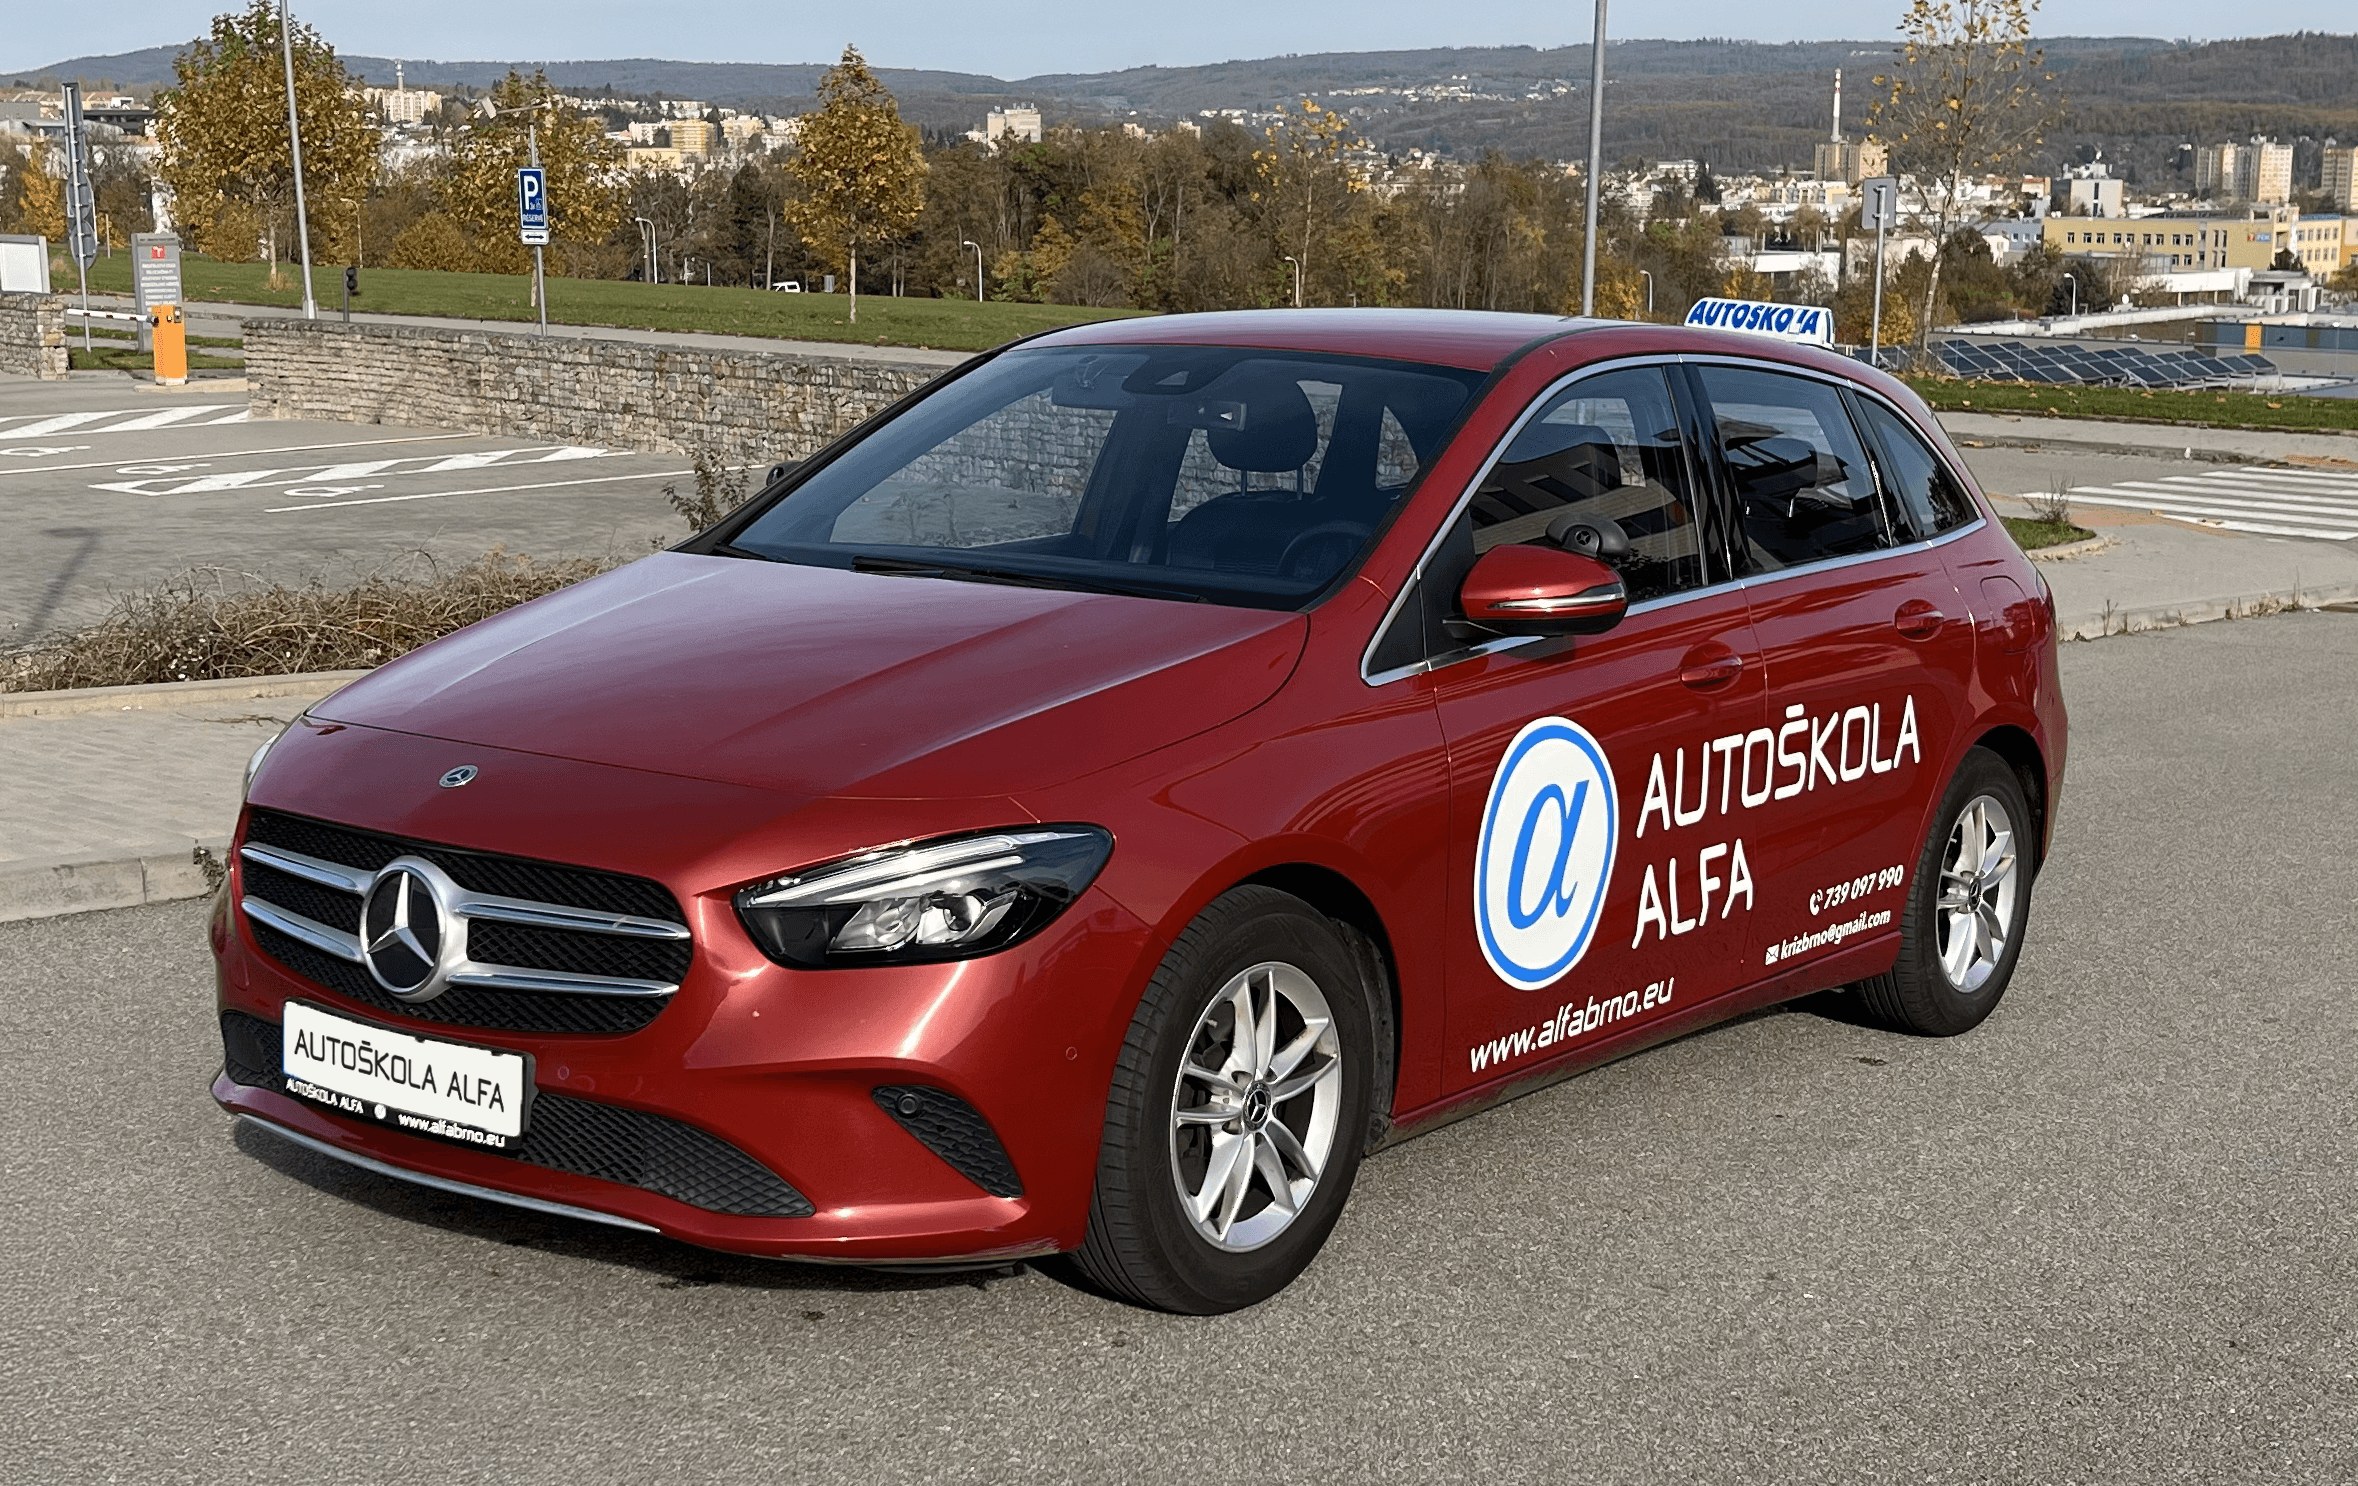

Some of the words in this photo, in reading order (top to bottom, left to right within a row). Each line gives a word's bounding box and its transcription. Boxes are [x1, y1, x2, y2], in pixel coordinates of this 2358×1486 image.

[523, 175, 539, 210] P
[1636, 695, 1920, 838] AUTOŠKOLA
[1632, 839, 1753, 949] ALFA
[1823, 882, 1851, 909] 739
[1850, 873, 1877, 899] 097
[1878, 865, 1904, 891] 990
[1780, 910, 1891, 959] krizbrno@gmail.com
[1470, 977, 1674, 1073] www.alfabrno.eu
[294, 1029, 436, 1094] AUTOŠKOLA
[446, 1071, 505, 1113] ALFA
[286, 1078, 338, 1106] AUTOŠKOLA
[339, 1096, 364, 1114] ALFA
[398, 1114, 505, 1148] www.alfabrno.eu
